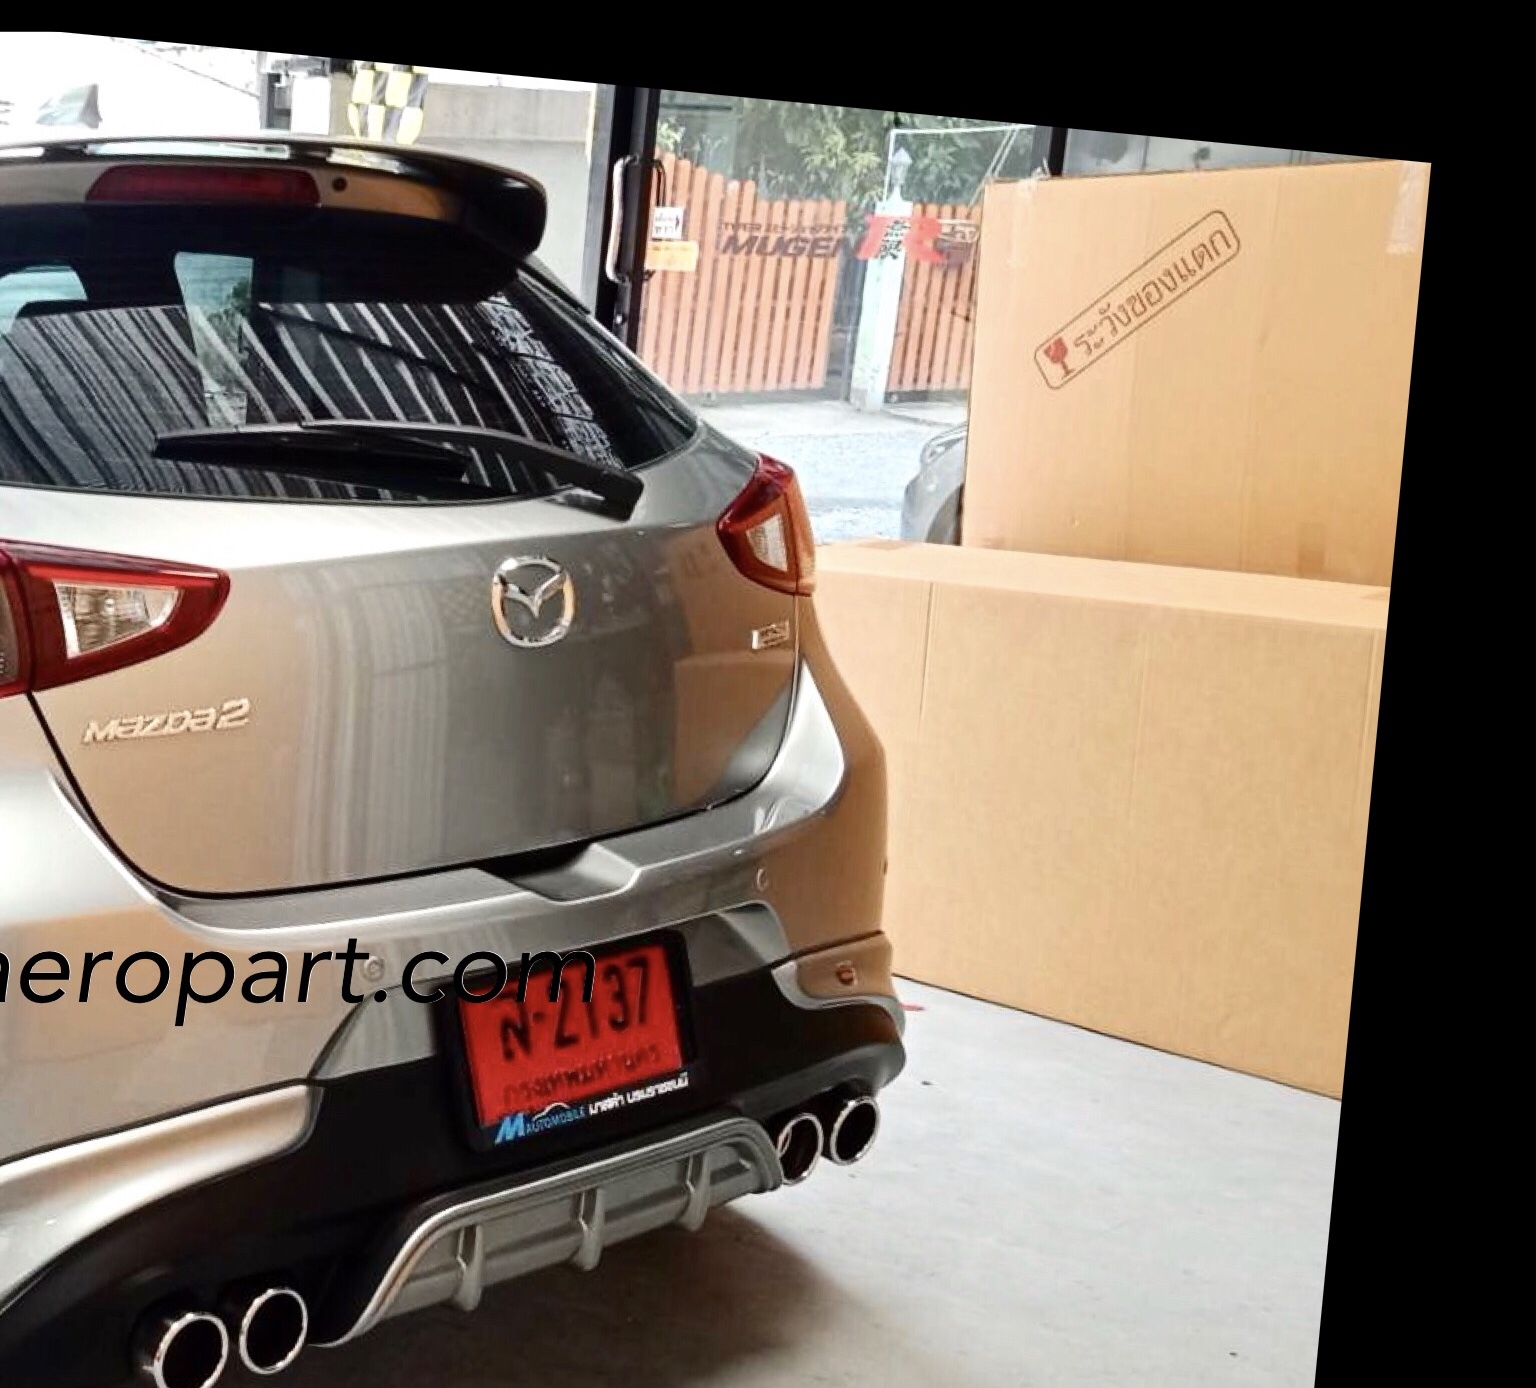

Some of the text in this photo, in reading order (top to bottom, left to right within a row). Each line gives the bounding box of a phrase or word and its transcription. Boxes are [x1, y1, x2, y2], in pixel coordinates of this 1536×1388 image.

[1073, 229, 1232, 357] ระวังของแตก
